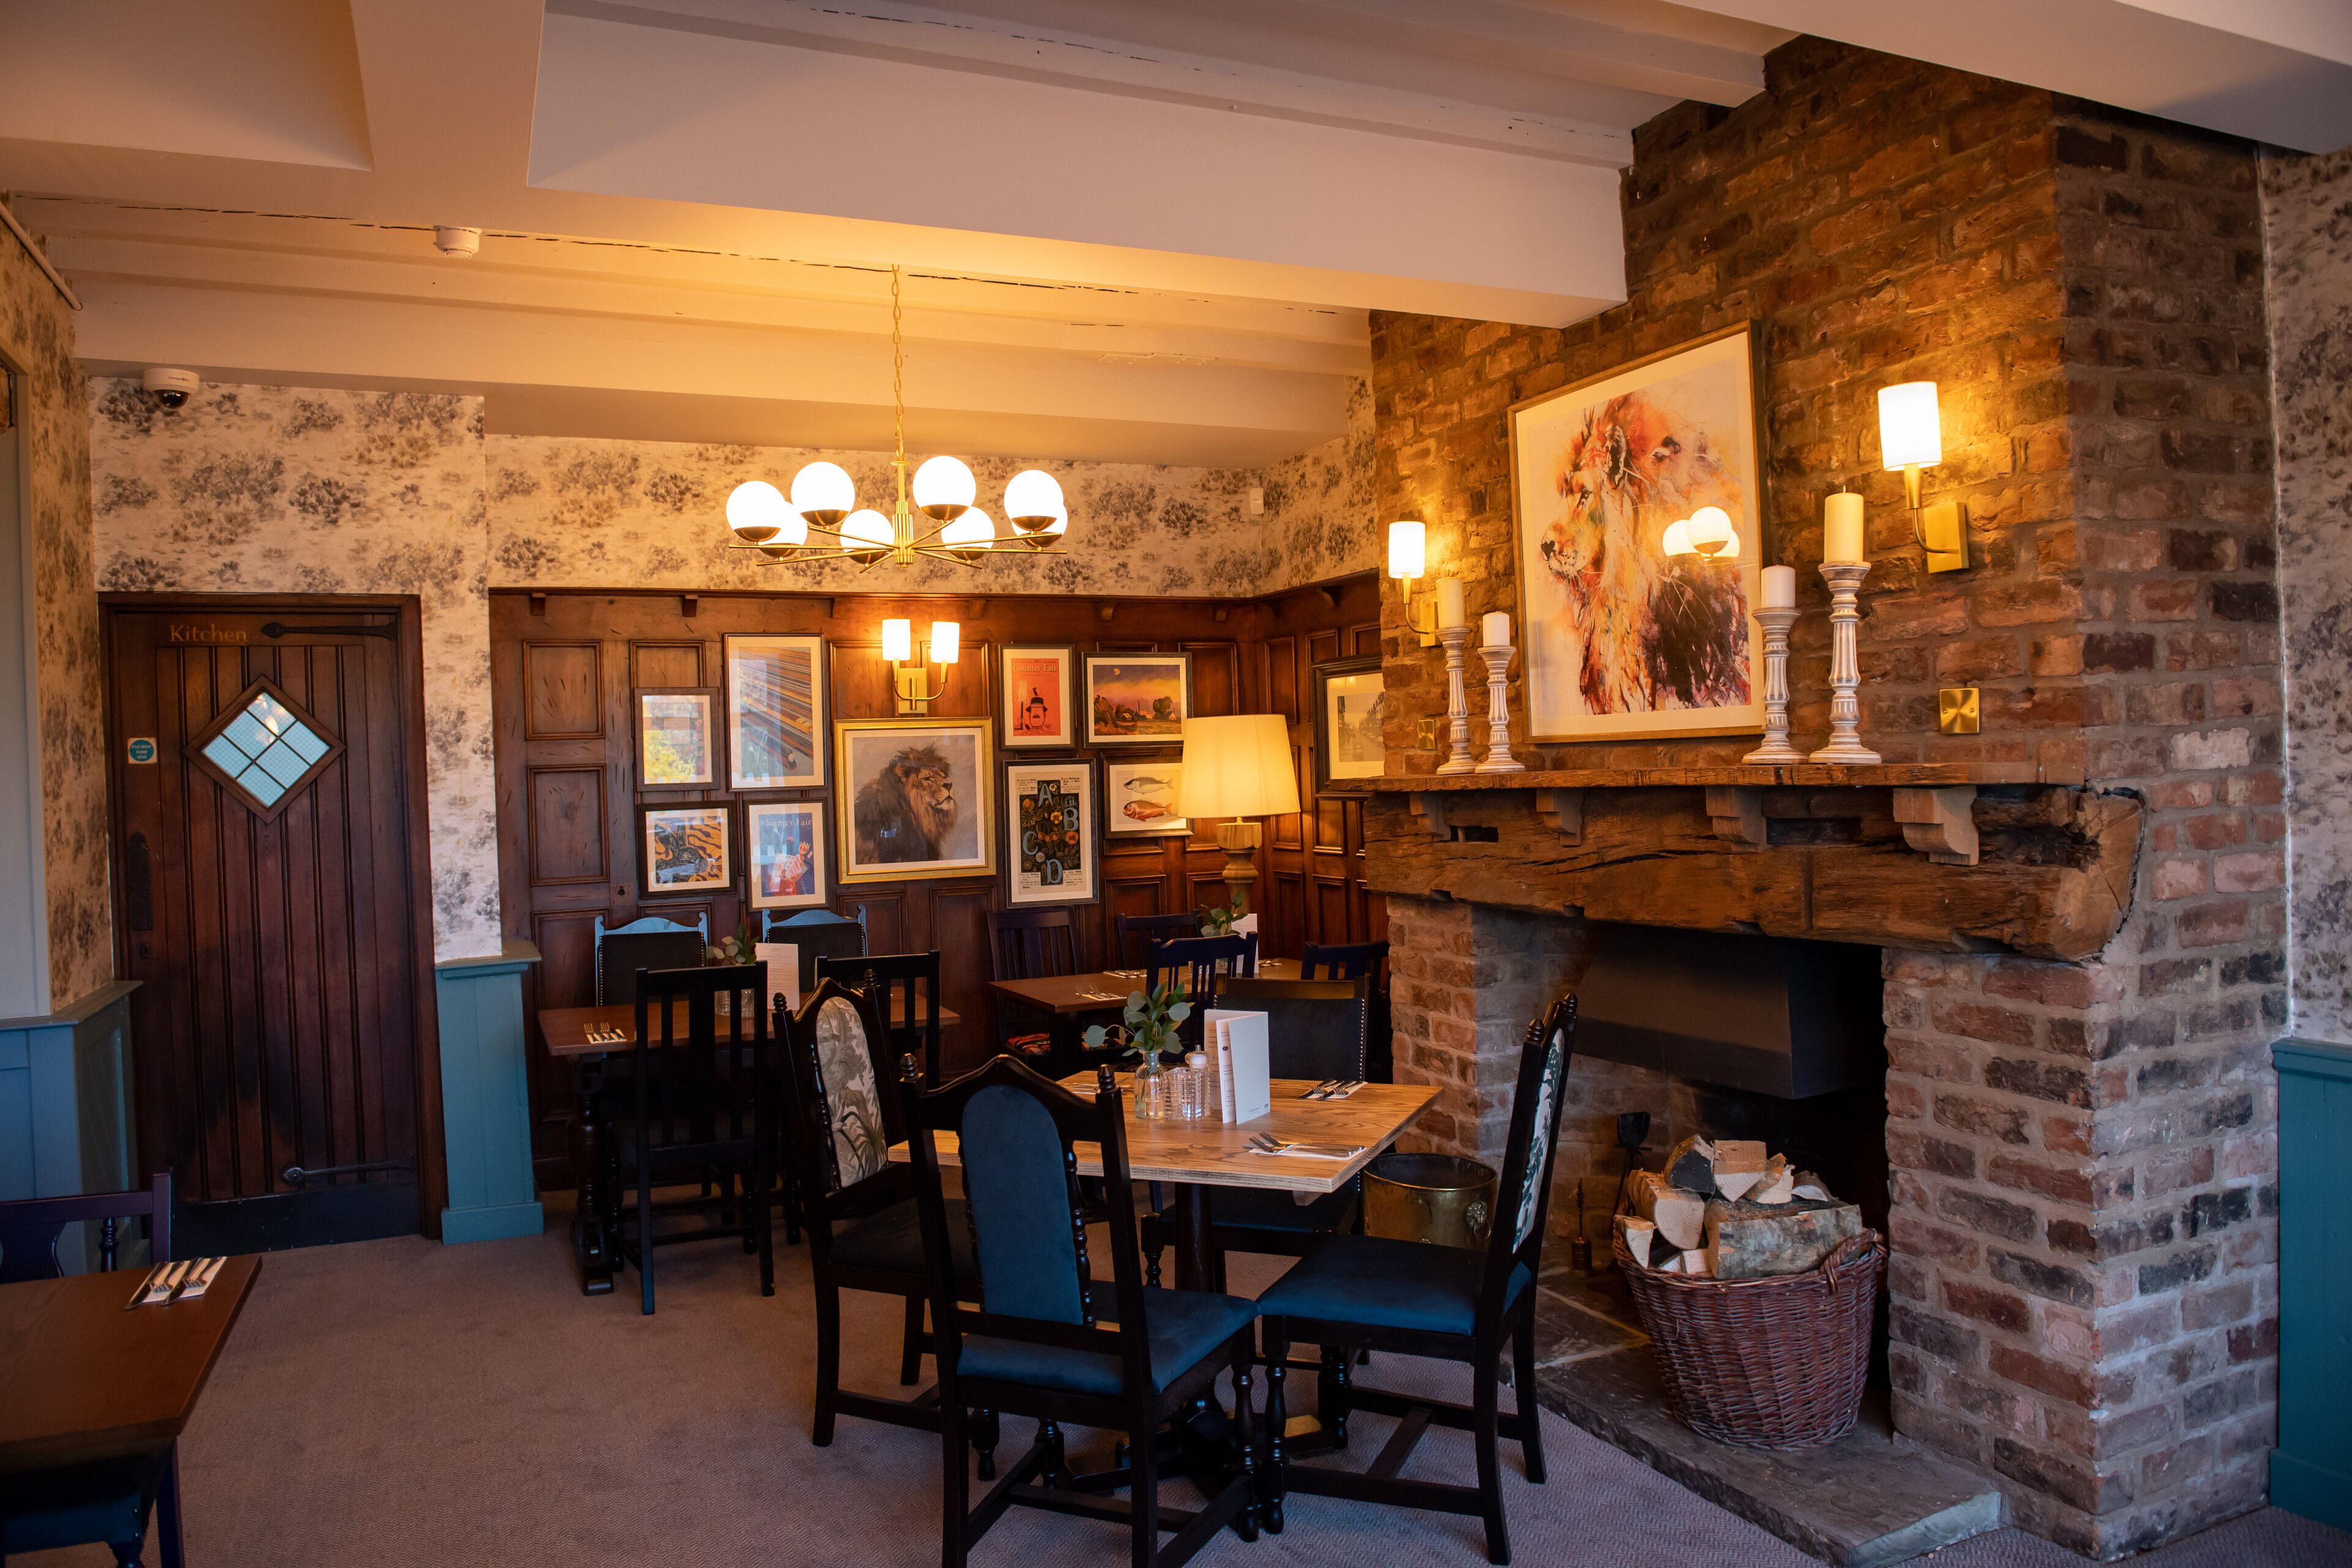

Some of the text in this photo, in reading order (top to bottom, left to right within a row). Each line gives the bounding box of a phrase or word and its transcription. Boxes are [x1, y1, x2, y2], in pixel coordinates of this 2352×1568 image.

[169, 624, 247, 642] Kitchen
[1013, 663, 1058, 673] Country Fair
[1038, 783, 1054, 807] A
[1064, 807, 1079, 831] B
[1022, 831, 1038, 855] C
[1046, 859, 1063, 883] D
